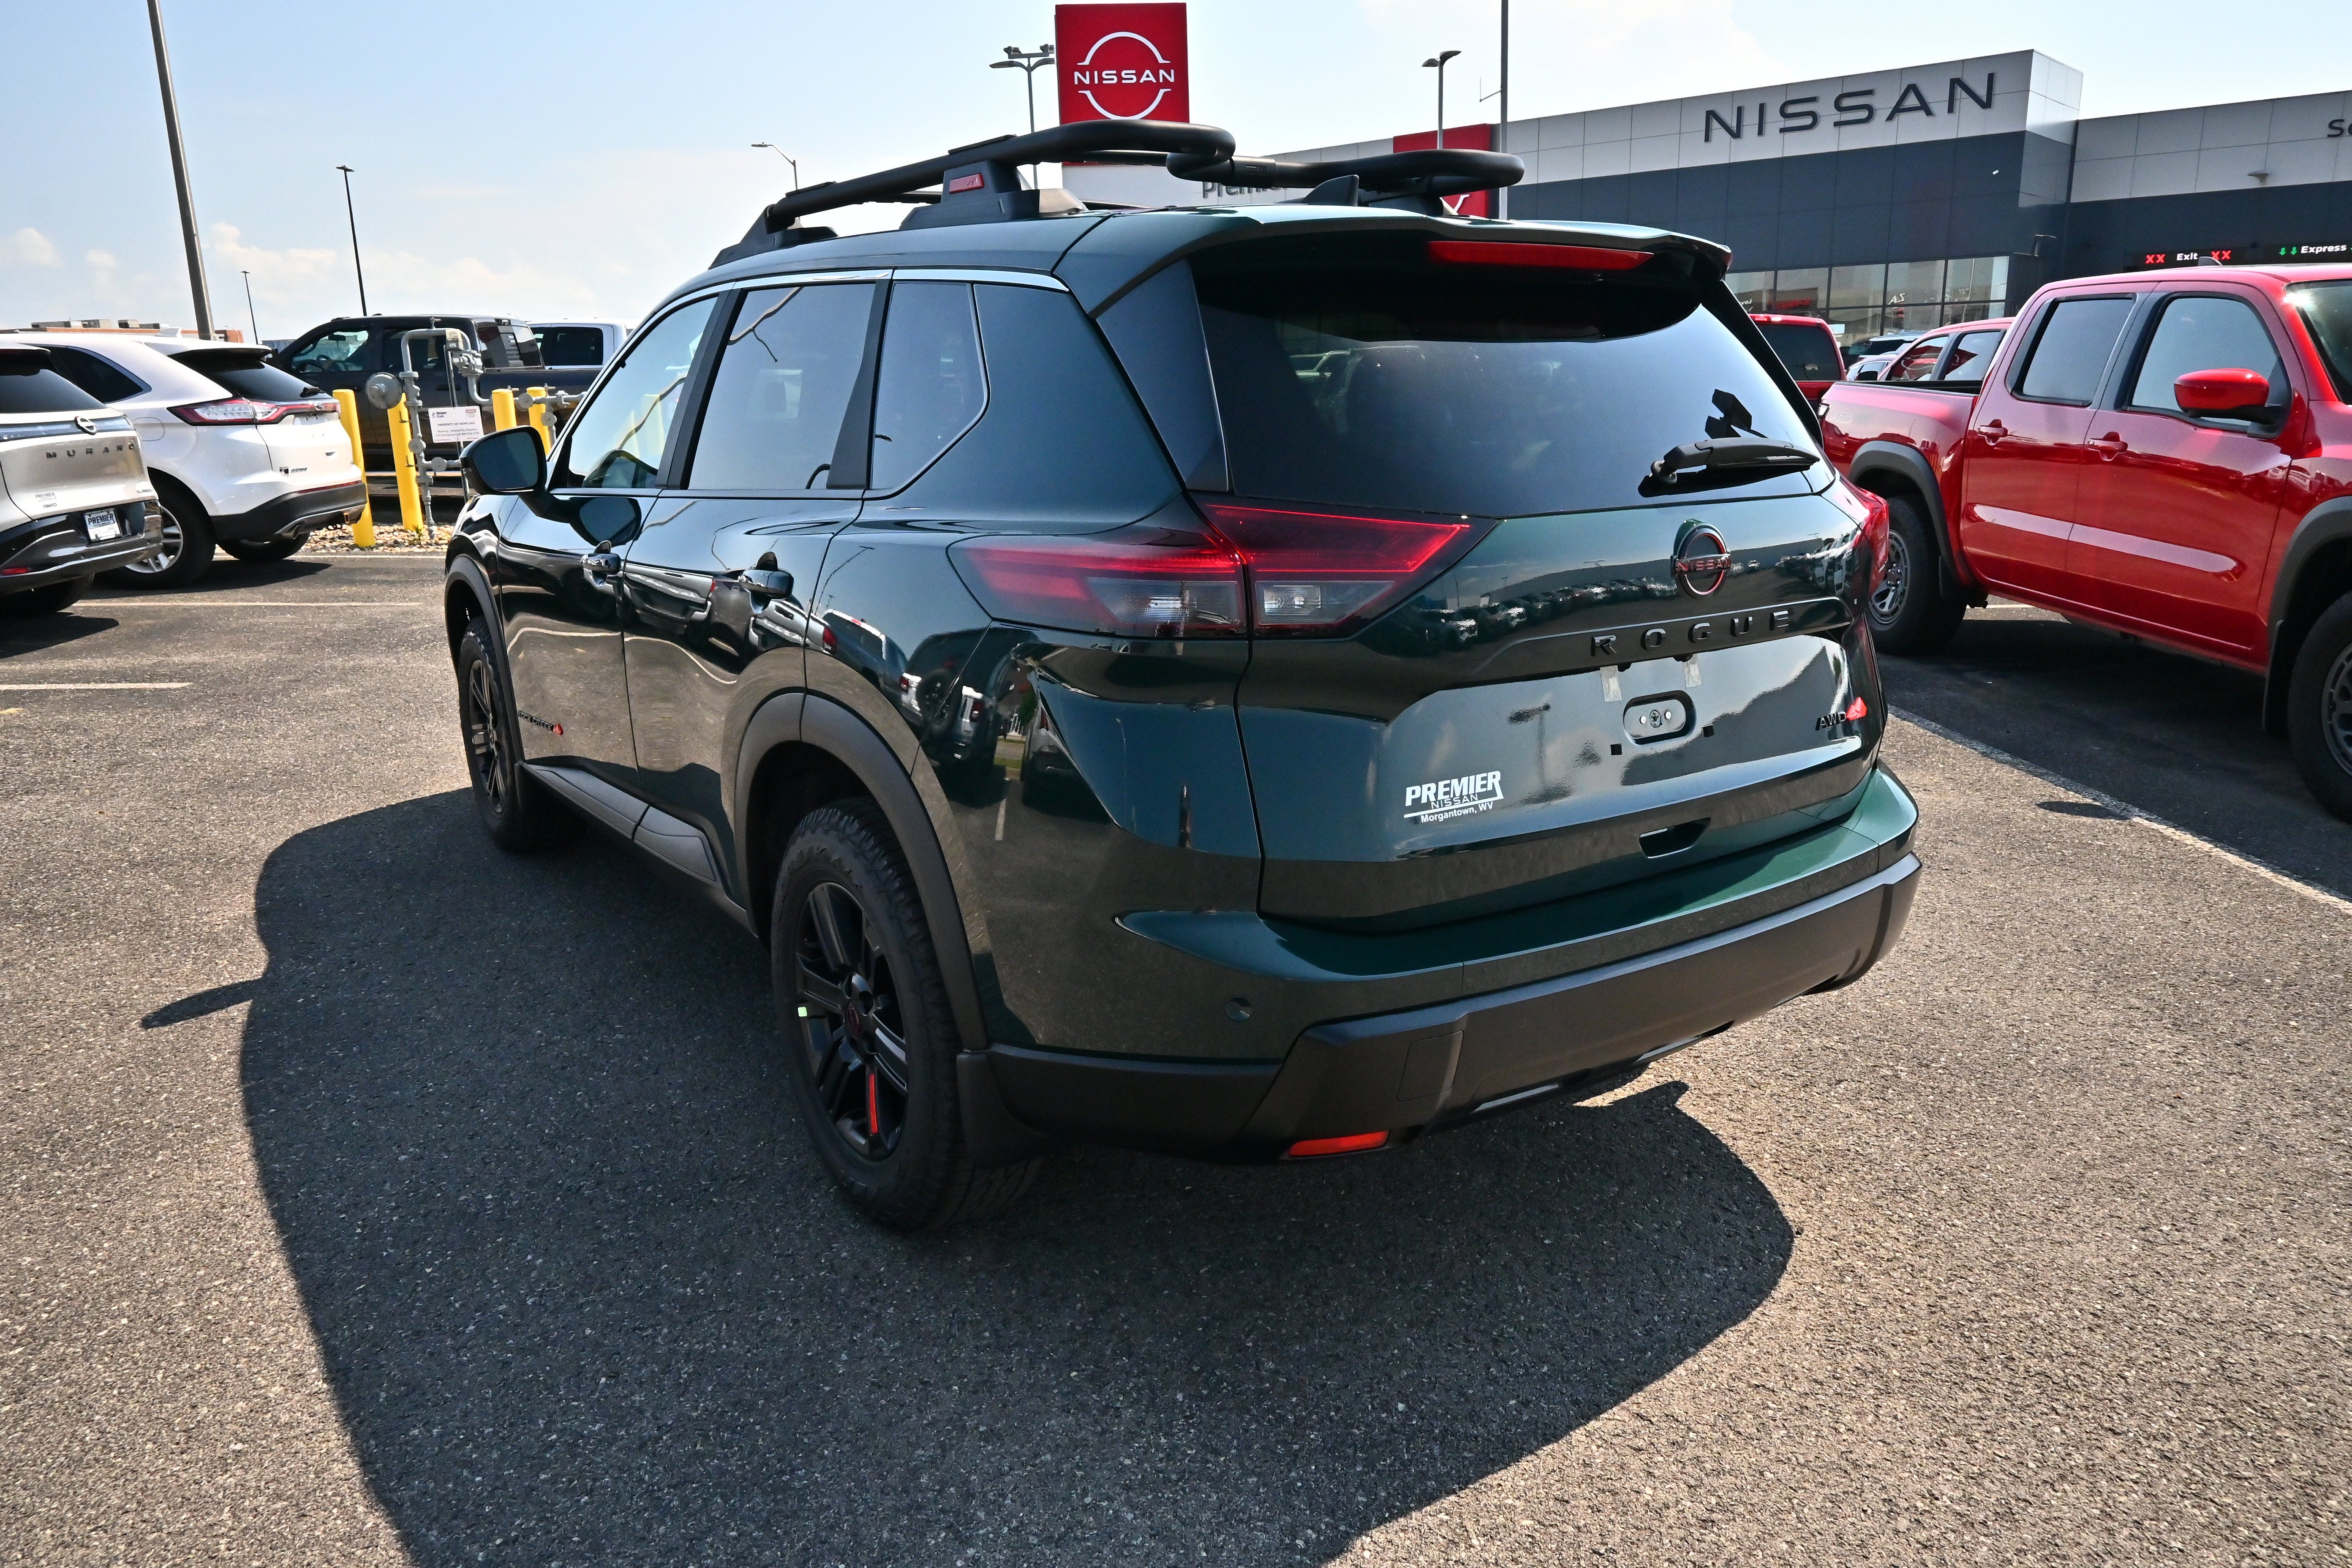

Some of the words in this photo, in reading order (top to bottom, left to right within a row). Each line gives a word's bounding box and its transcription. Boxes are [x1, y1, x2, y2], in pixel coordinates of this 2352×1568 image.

[1074, 69, 1175, 85] NISSAN
[1704, 72, 1995, 143] NISSAN
[2327, 119, 2352, 138] S
[2176, 252, 2198, 261] Exit
[2301, 245, 2347, 254] Express
[46, 441, 135, 458] MURANO
[88, 513, 115, 525] PREMIER
[1678, 555, 1731, 571] NISSAN
[1591, 610, 1789, 656] ROGUE
[1816, 711, 1847, 731] AWD
[1405, 770, 1504, 806] PREMIER
[1431, 793, 1478, 809] NISSAN
[1421, 806, 1477, 823] Morgantown,
[1478, 801, 1493, 811] WV
